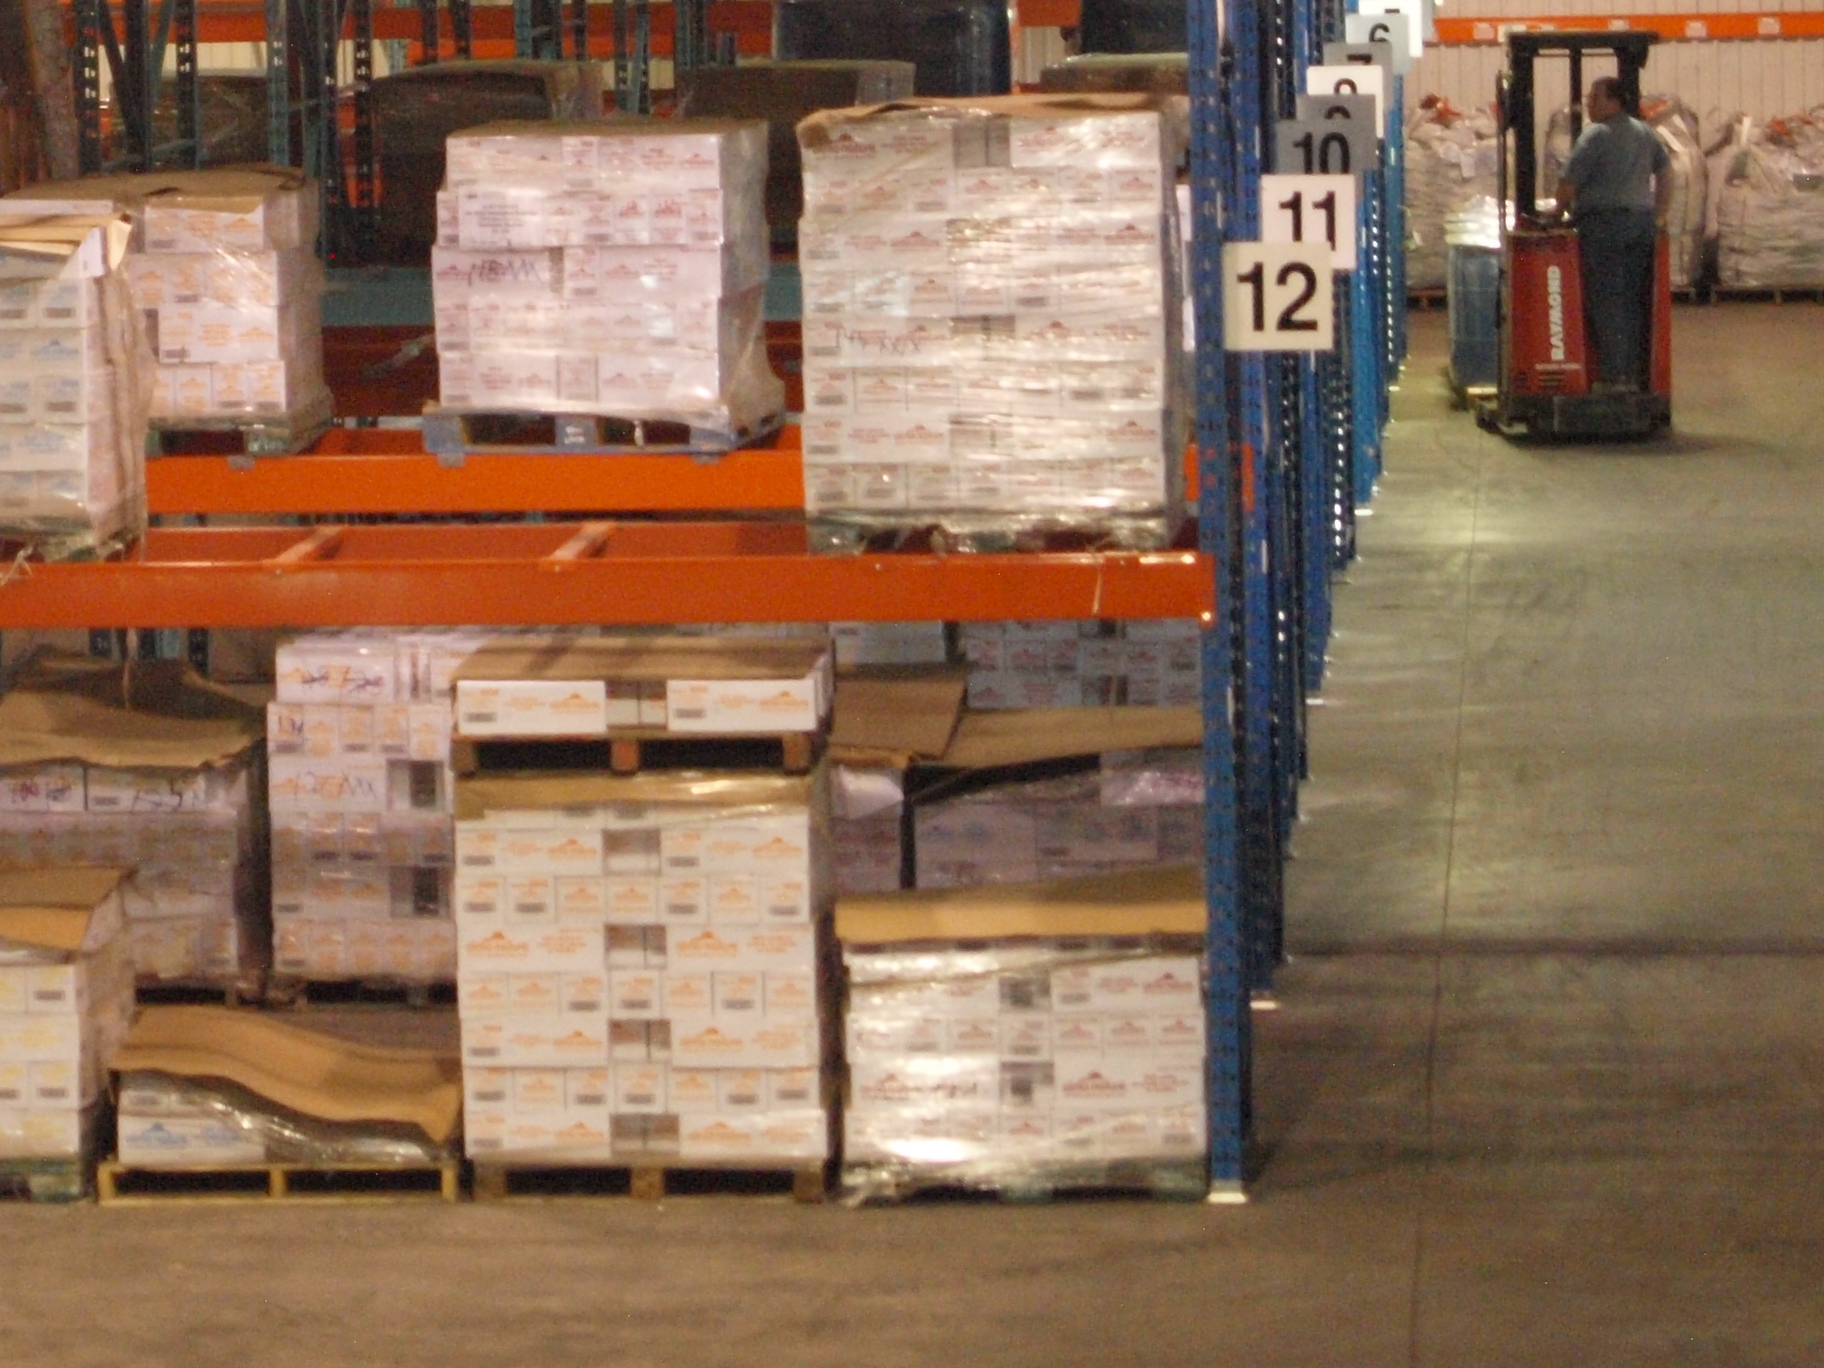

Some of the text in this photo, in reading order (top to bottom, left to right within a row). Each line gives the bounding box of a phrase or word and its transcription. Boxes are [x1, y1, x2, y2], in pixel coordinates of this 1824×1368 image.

[1292, 132, 1350, 175] 10
[1279, 191, 1336, 252] 11
[1237, 262, 1318, 332] 12
[1547, 265, 1565, 361] RAYMOND
